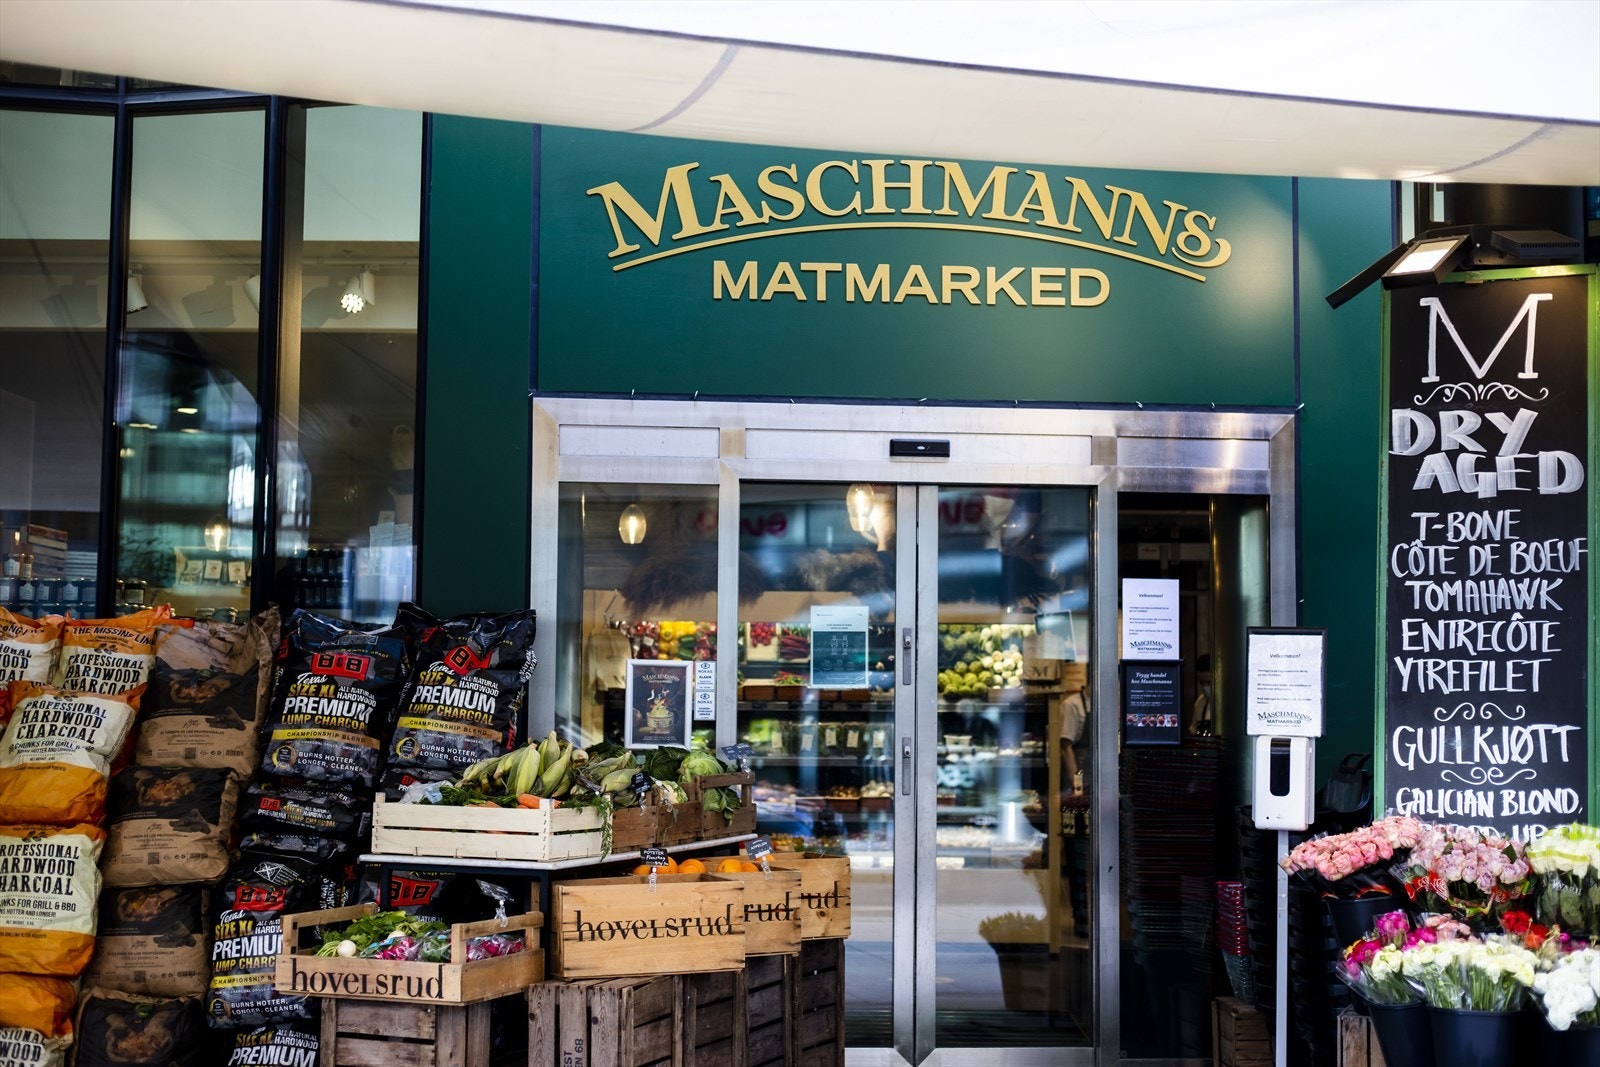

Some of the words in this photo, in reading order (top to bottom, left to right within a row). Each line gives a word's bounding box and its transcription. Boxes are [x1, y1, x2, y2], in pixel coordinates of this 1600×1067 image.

[712, 259, 1111, 308] MATMARKED
[1419, 293, 1554, 383] M
[1389, 407, 1539, 457] DRY
[1413, 450, 1585, 499] AGED
[1410, 509, 1522, 543] T-BONE
[1391, 538, 1460, 578] CÔTE
[1469, 543, 1503, 577] DE
[1510, 537, 1589, 575] BOEUF
[1404, 577, 1564, 615] TOMAHAWK
[1401, 611, 1563, 656] ENTRECÔTE
[67, 653, 144, 670] PROFESSIONAL
[317, 654, 364, 674] B&B
[65, 664, 141, 684] HARDWOOD
[297, 672, 329, 686] Texas
[419, 671, 442, 686] SIZE
[473, 676, 499, 690] NATURAL
[1394, 656, 1553, 695] YTREFILET
[288, 684, 318, 698] SIZE
[318, 684, 336, 699] XL
[459, 680, 500, 698] HARDWOOD
[337, 691, 377, 708] HARDWOOD
[411, 685, 497, 715] PREMIUM
[24, 700, 107, 719] PROFESSIONAL
[283, 696, 374, 725] PREMIUM
[408, 703, 434, 714] LUMP
[436, 705, 495, 726] CHARCOAL
[20, 710, 103, 729] HARDWOOD
[281, 714, 312, 725] LUMP
[409, 719, 461, 731] CHAMPIONSHIP
[463, 726, 488, 736] BLEND
[16, 723, 97, 745] CHARCOAL
[286, 731, 340, 739] CHAMPIONSHIP
[341, 734, 367, 743] BLEND
[41, 740, 55, 748] FOR
[421, 743, 445, 753] BURNS
[447, 747, 478, 759] HOTTER,
[1392, 724, 1582, 772] GULLKJØTT
[297, 758, 329, 768] LONGER,
[298, 751, 323, 760] BURNS
[324, 754, 356, 765] HOTTER,
[420, 750, 451, 761] LONGER,
[1395, 787, 1494, 819] GALICIAN
[0, 844, 80, 860] ROFESSIONAL
[0, 858, 76, 877] ARDWOOD
[0, 875, 74, 896] HARCOAL
[17, 899, 31, 908] FOR
[32, 900, 53, 910] GRILL
[54, 901, 60, 911] &
[61, 902, 77, 912] BBQ
[220, 910, 246, 927] Texas
[215, 921, 236, 940] SIZE
[211, 959, 236, 972] UMP
[239, 956, 275, 969] CHARC
[214, 976, 265, 985] CHAMPIONSHIP
[231, 1001, 254, 1009] BURNS
[274, 1036, 319, 1050] HARDWOOD
[288, 1030, 318, 1041] NATURAL
[574, 1038, 584, 1053] 68
[228, 1045, 316, 1067] PREMIUM
